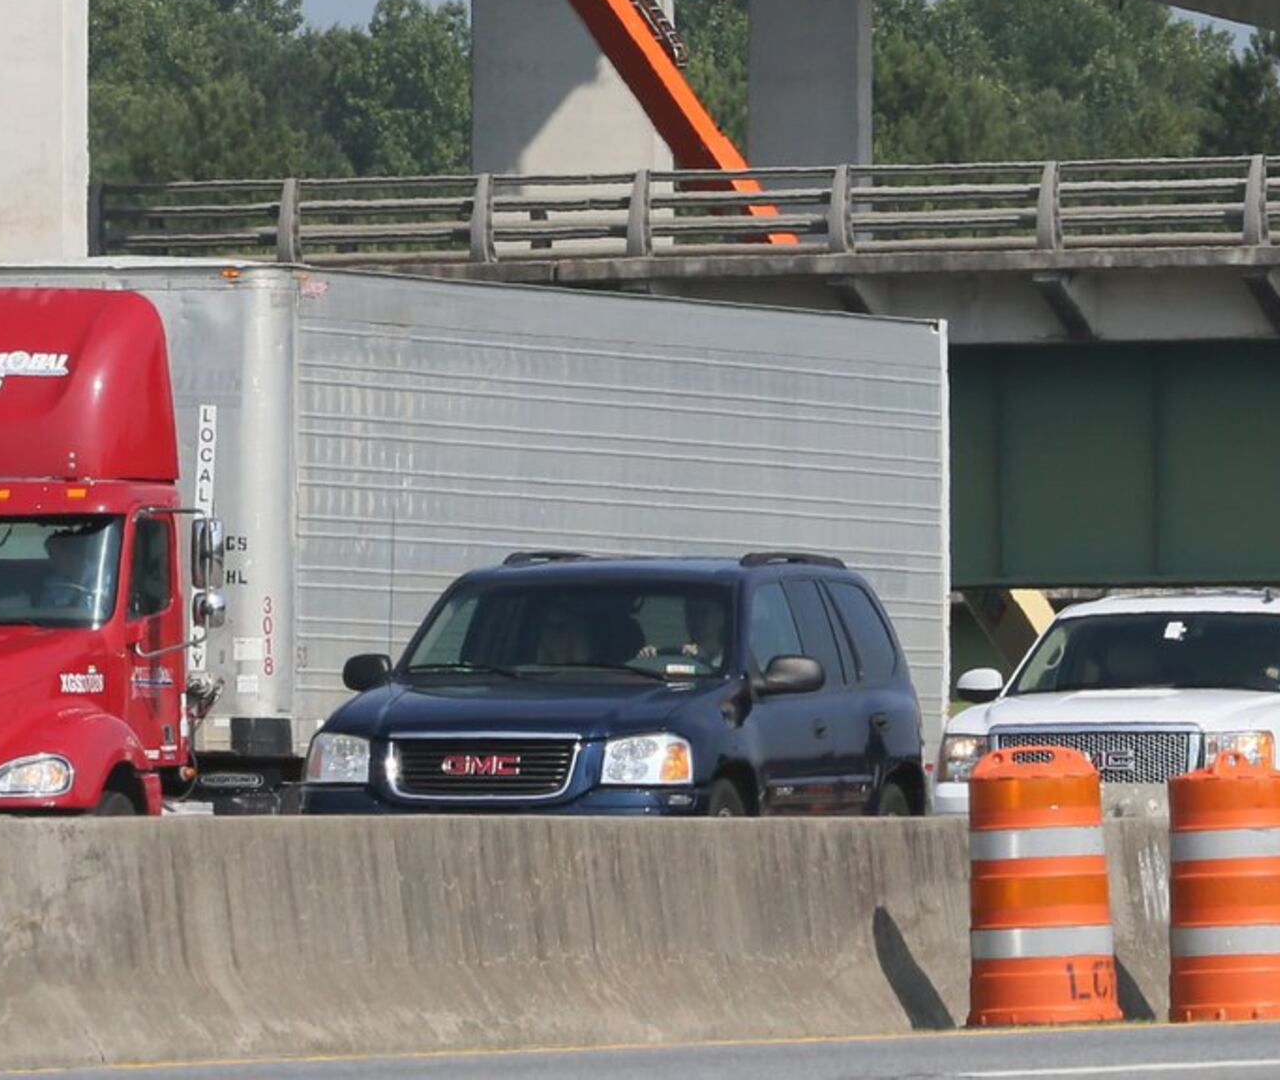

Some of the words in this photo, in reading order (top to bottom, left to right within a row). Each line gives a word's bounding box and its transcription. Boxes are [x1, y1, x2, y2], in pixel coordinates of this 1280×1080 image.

[198, 408, 214, 502] LOCAL
[262, 596, 274, 676] 3018
[441, 754, 521, 776] GMC
